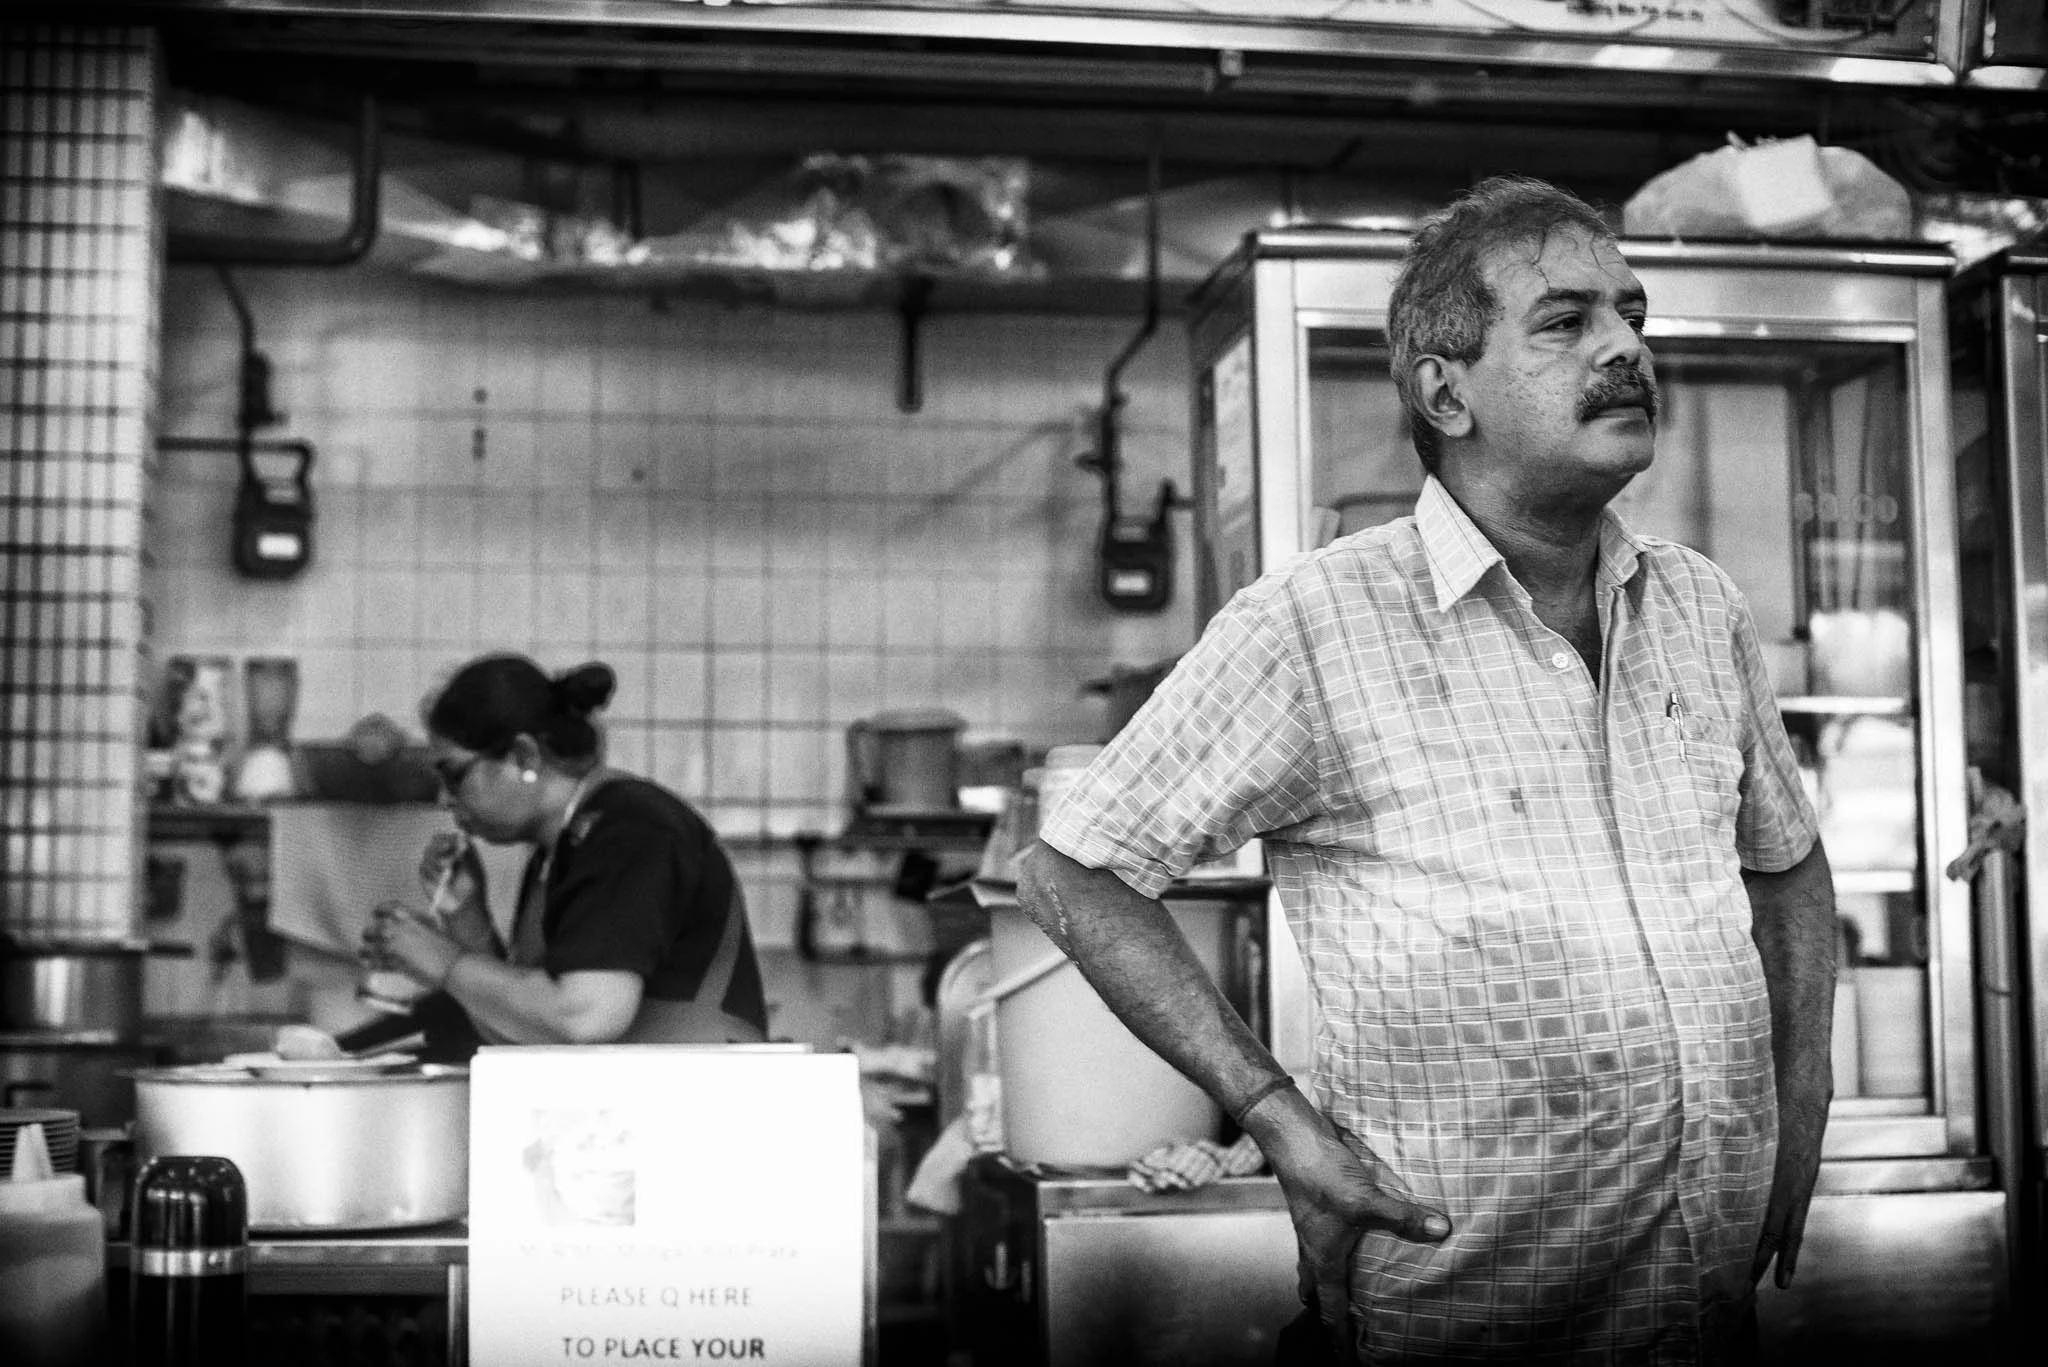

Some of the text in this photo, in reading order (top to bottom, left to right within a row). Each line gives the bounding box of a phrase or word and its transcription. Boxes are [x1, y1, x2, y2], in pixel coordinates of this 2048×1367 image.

[560, 1287, 752, 1309] PLEASE Q HERE
[562, 1337, 766, 1359] TO PLACE YOUR
